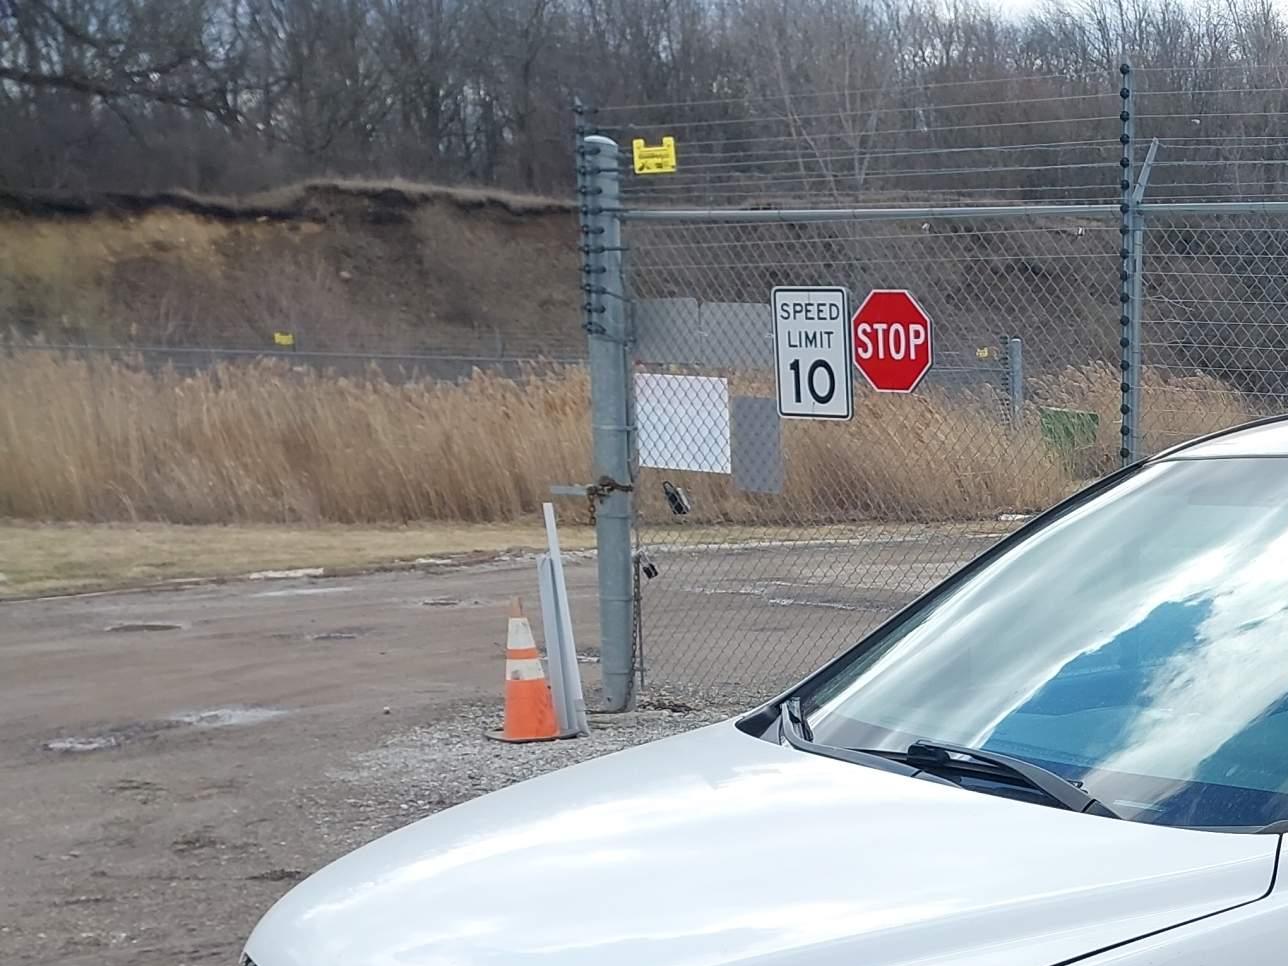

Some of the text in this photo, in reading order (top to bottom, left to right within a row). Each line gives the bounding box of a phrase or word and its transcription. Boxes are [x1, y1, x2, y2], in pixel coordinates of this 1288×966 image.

[780, 303, 840, 321] SPEED
[788, 331, 834, 349] LIMIT
[857, 322, 926, 361] STOP
[789, 358, 836, 405] 10
